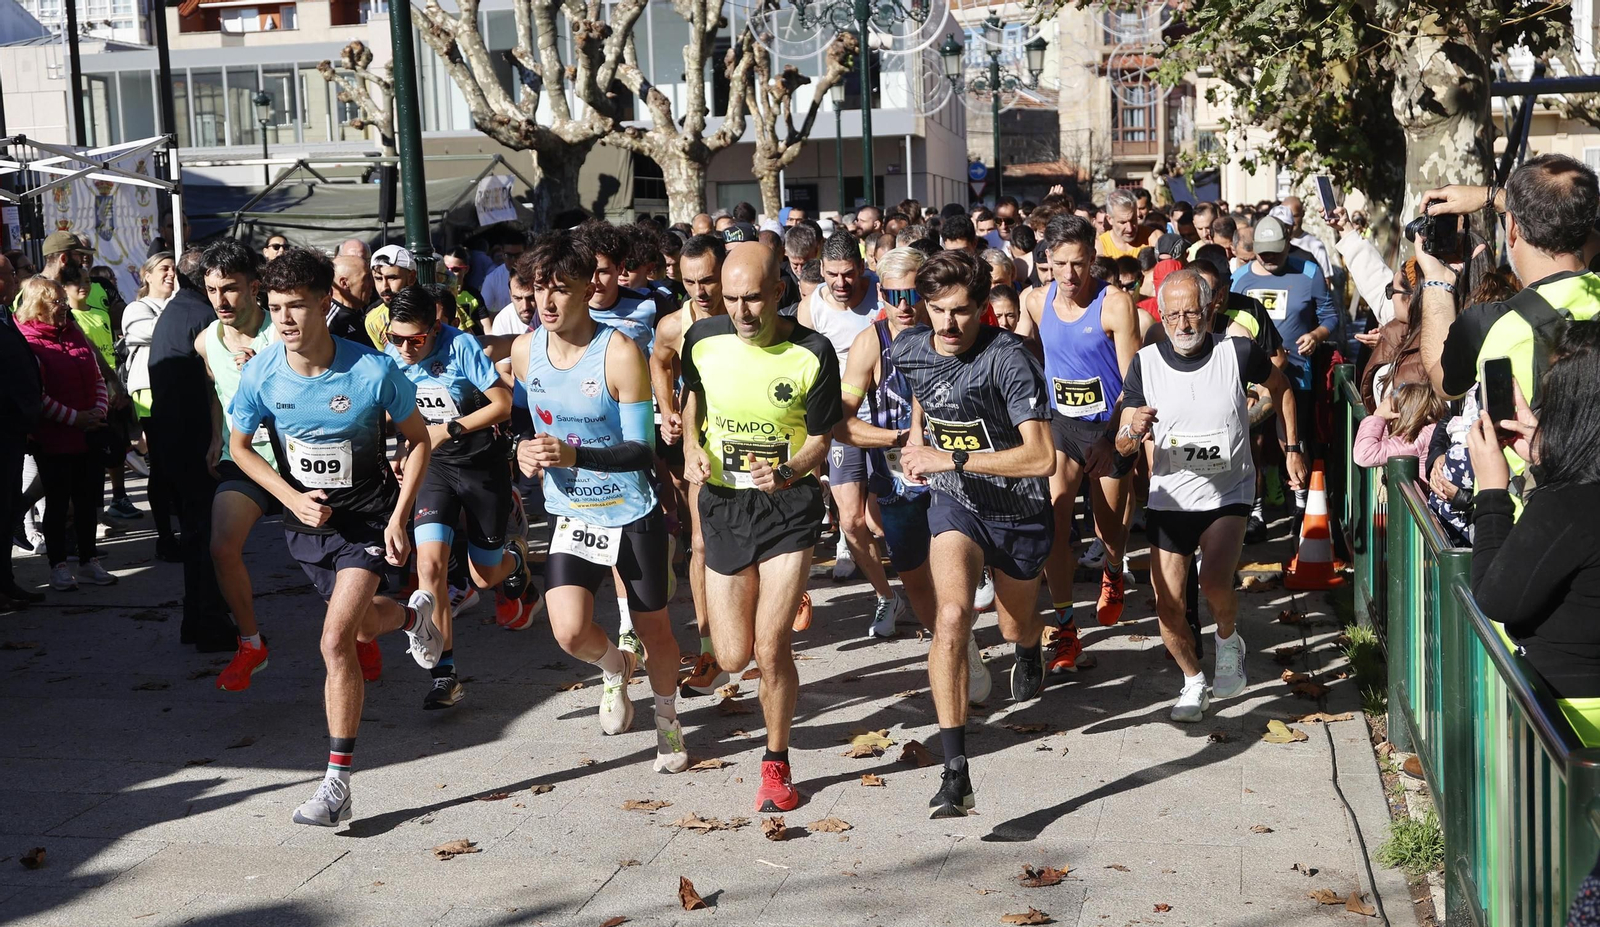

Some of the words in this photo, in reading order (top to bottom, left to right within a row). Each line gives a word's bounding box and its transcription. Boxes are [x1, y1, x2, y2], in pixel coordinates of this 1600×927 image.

[416, 397, 446, 408] 914
[1065, 391, 1096, 406] 170
[556, 414, 584, 424] Saunier
[584, 414, 607, 424] Duval
[716, 416, 775, 435] AVEMPO
[940, 434, 981, 451] 243
[1184, 445, 1221, 461] 742
[300, 458, 341, 474] 909
[740, 454, 780, 472] 17
[565, 483, 621, 497] RODOSA
[571, 529, 609, 550] 908
